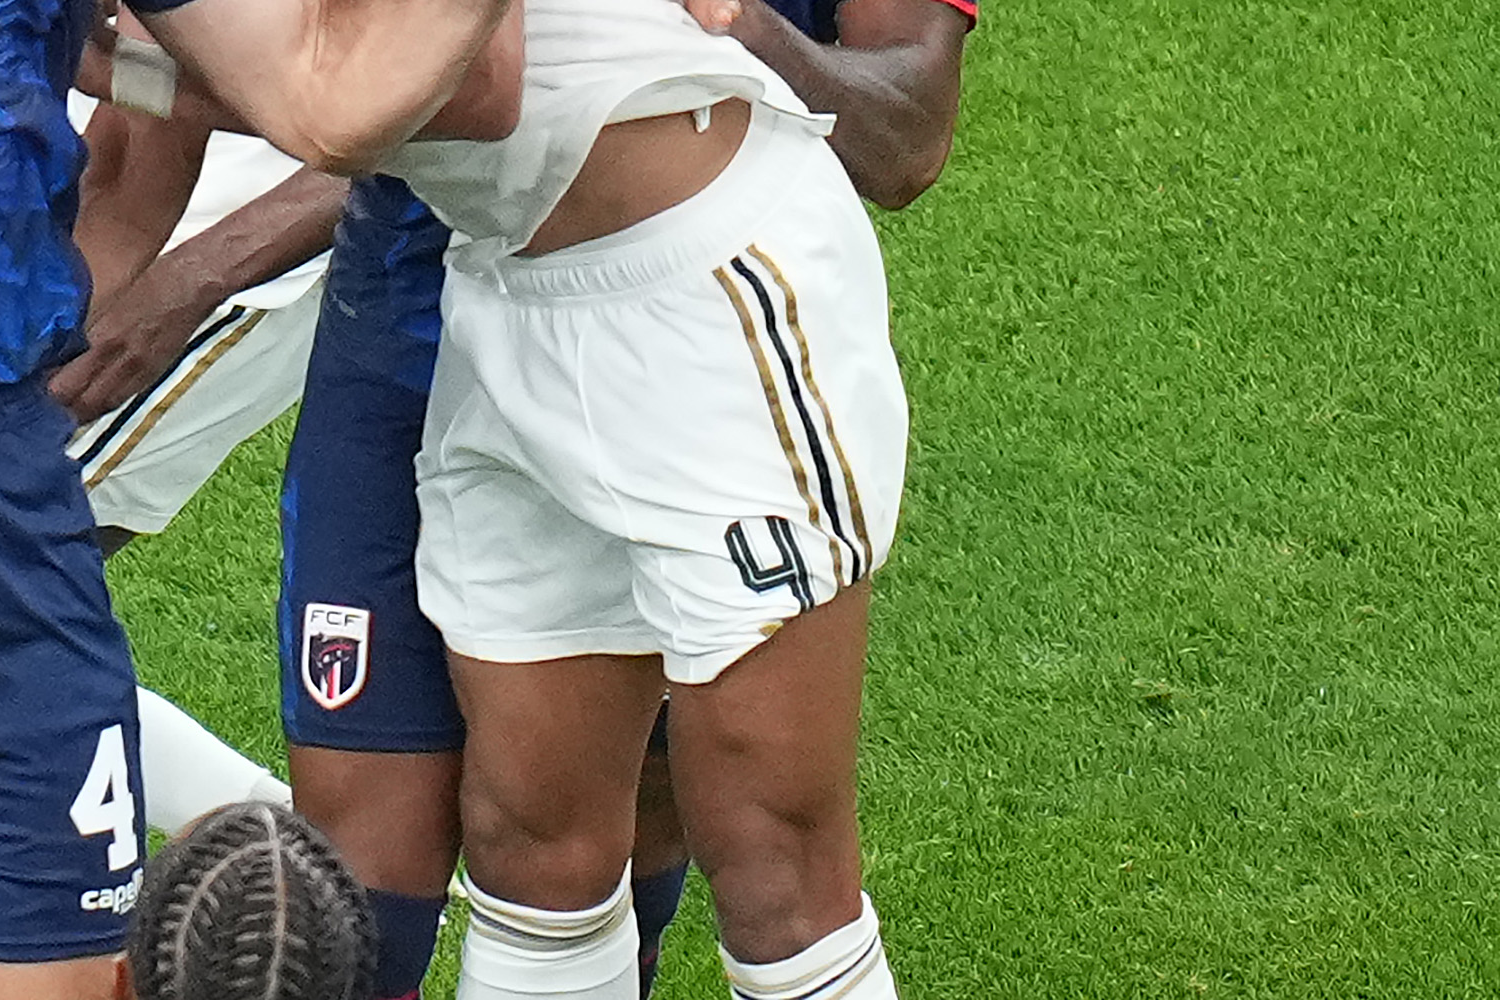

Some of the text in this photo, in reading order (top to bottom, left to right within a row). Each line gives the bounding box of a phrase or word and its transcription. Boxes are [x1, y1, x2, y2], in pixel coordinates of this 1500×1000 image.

[724, 514, 815, 612] 4
[310, 609, 362, 627] FCF
[69, 723, 139, 872] 4
